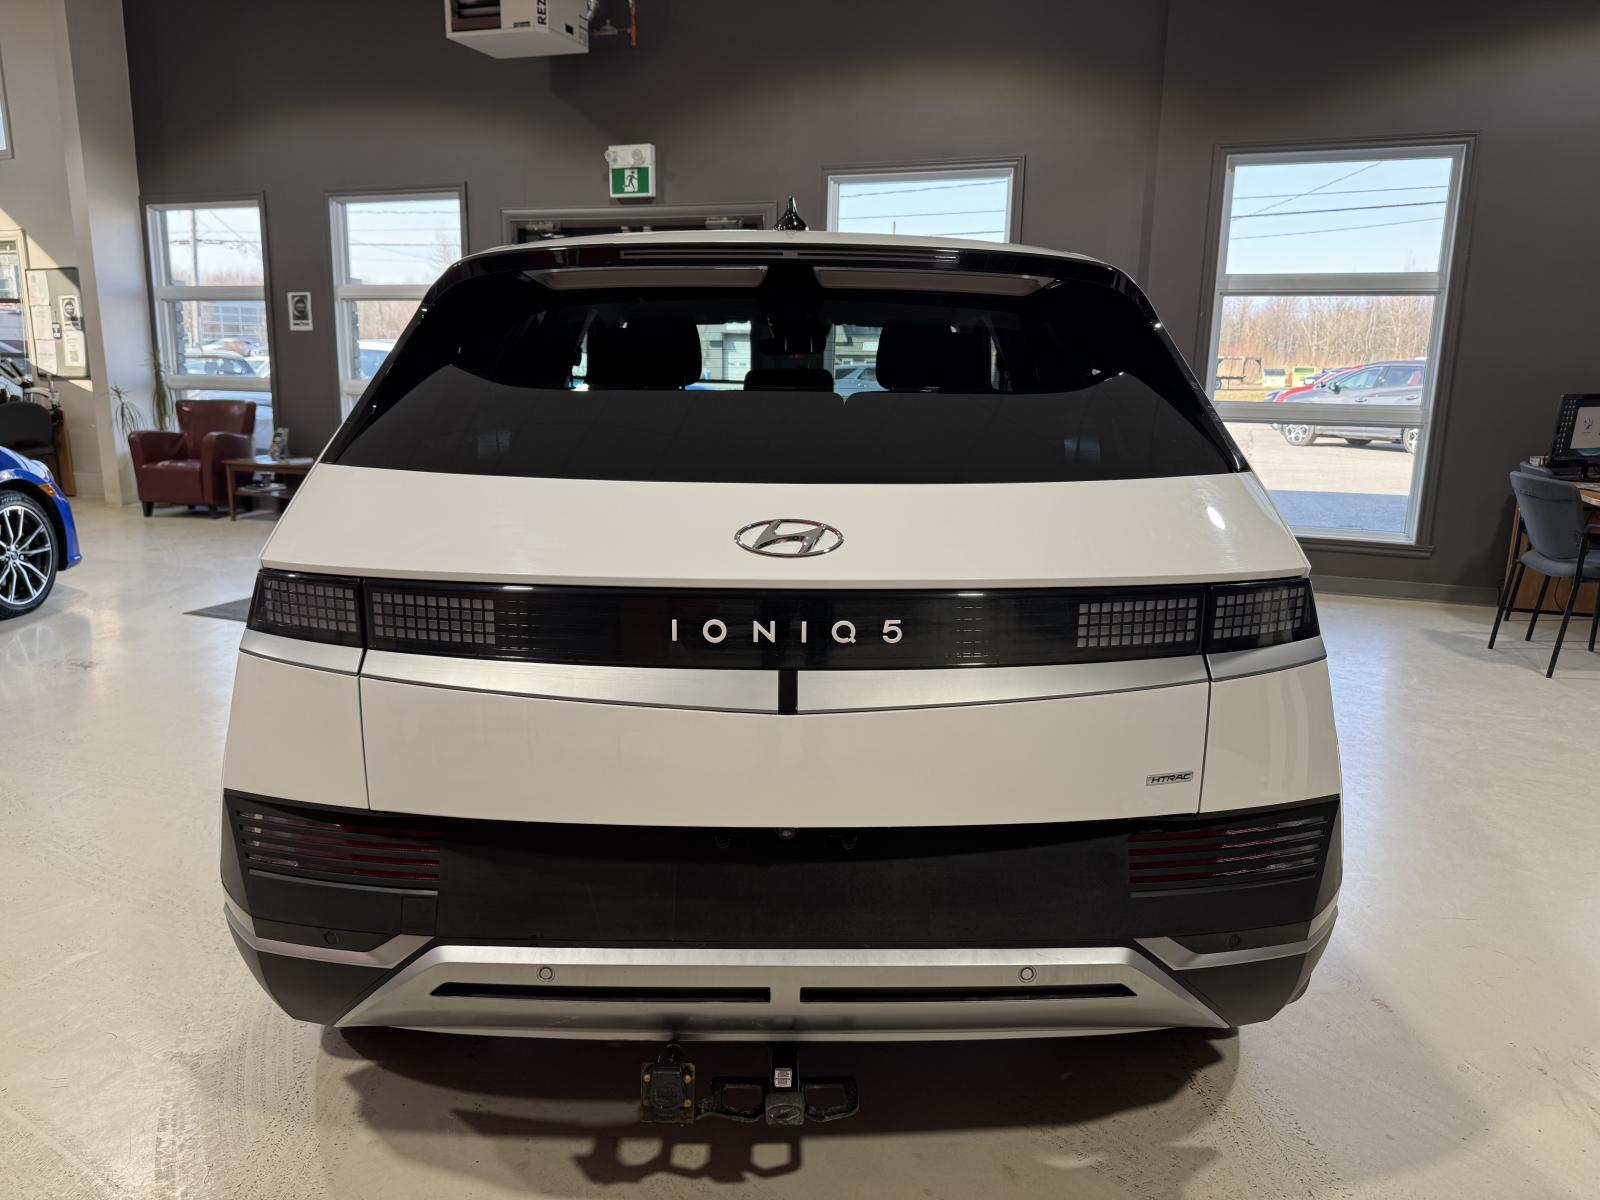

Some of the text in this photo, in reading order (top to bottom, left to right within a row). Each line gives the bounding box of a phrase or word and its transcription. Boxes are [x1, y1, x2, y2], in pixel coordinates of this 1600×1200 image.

[671, 618, 903, 644] IONIQ 5
[1151, 773, 1191, 783] HTRAC
